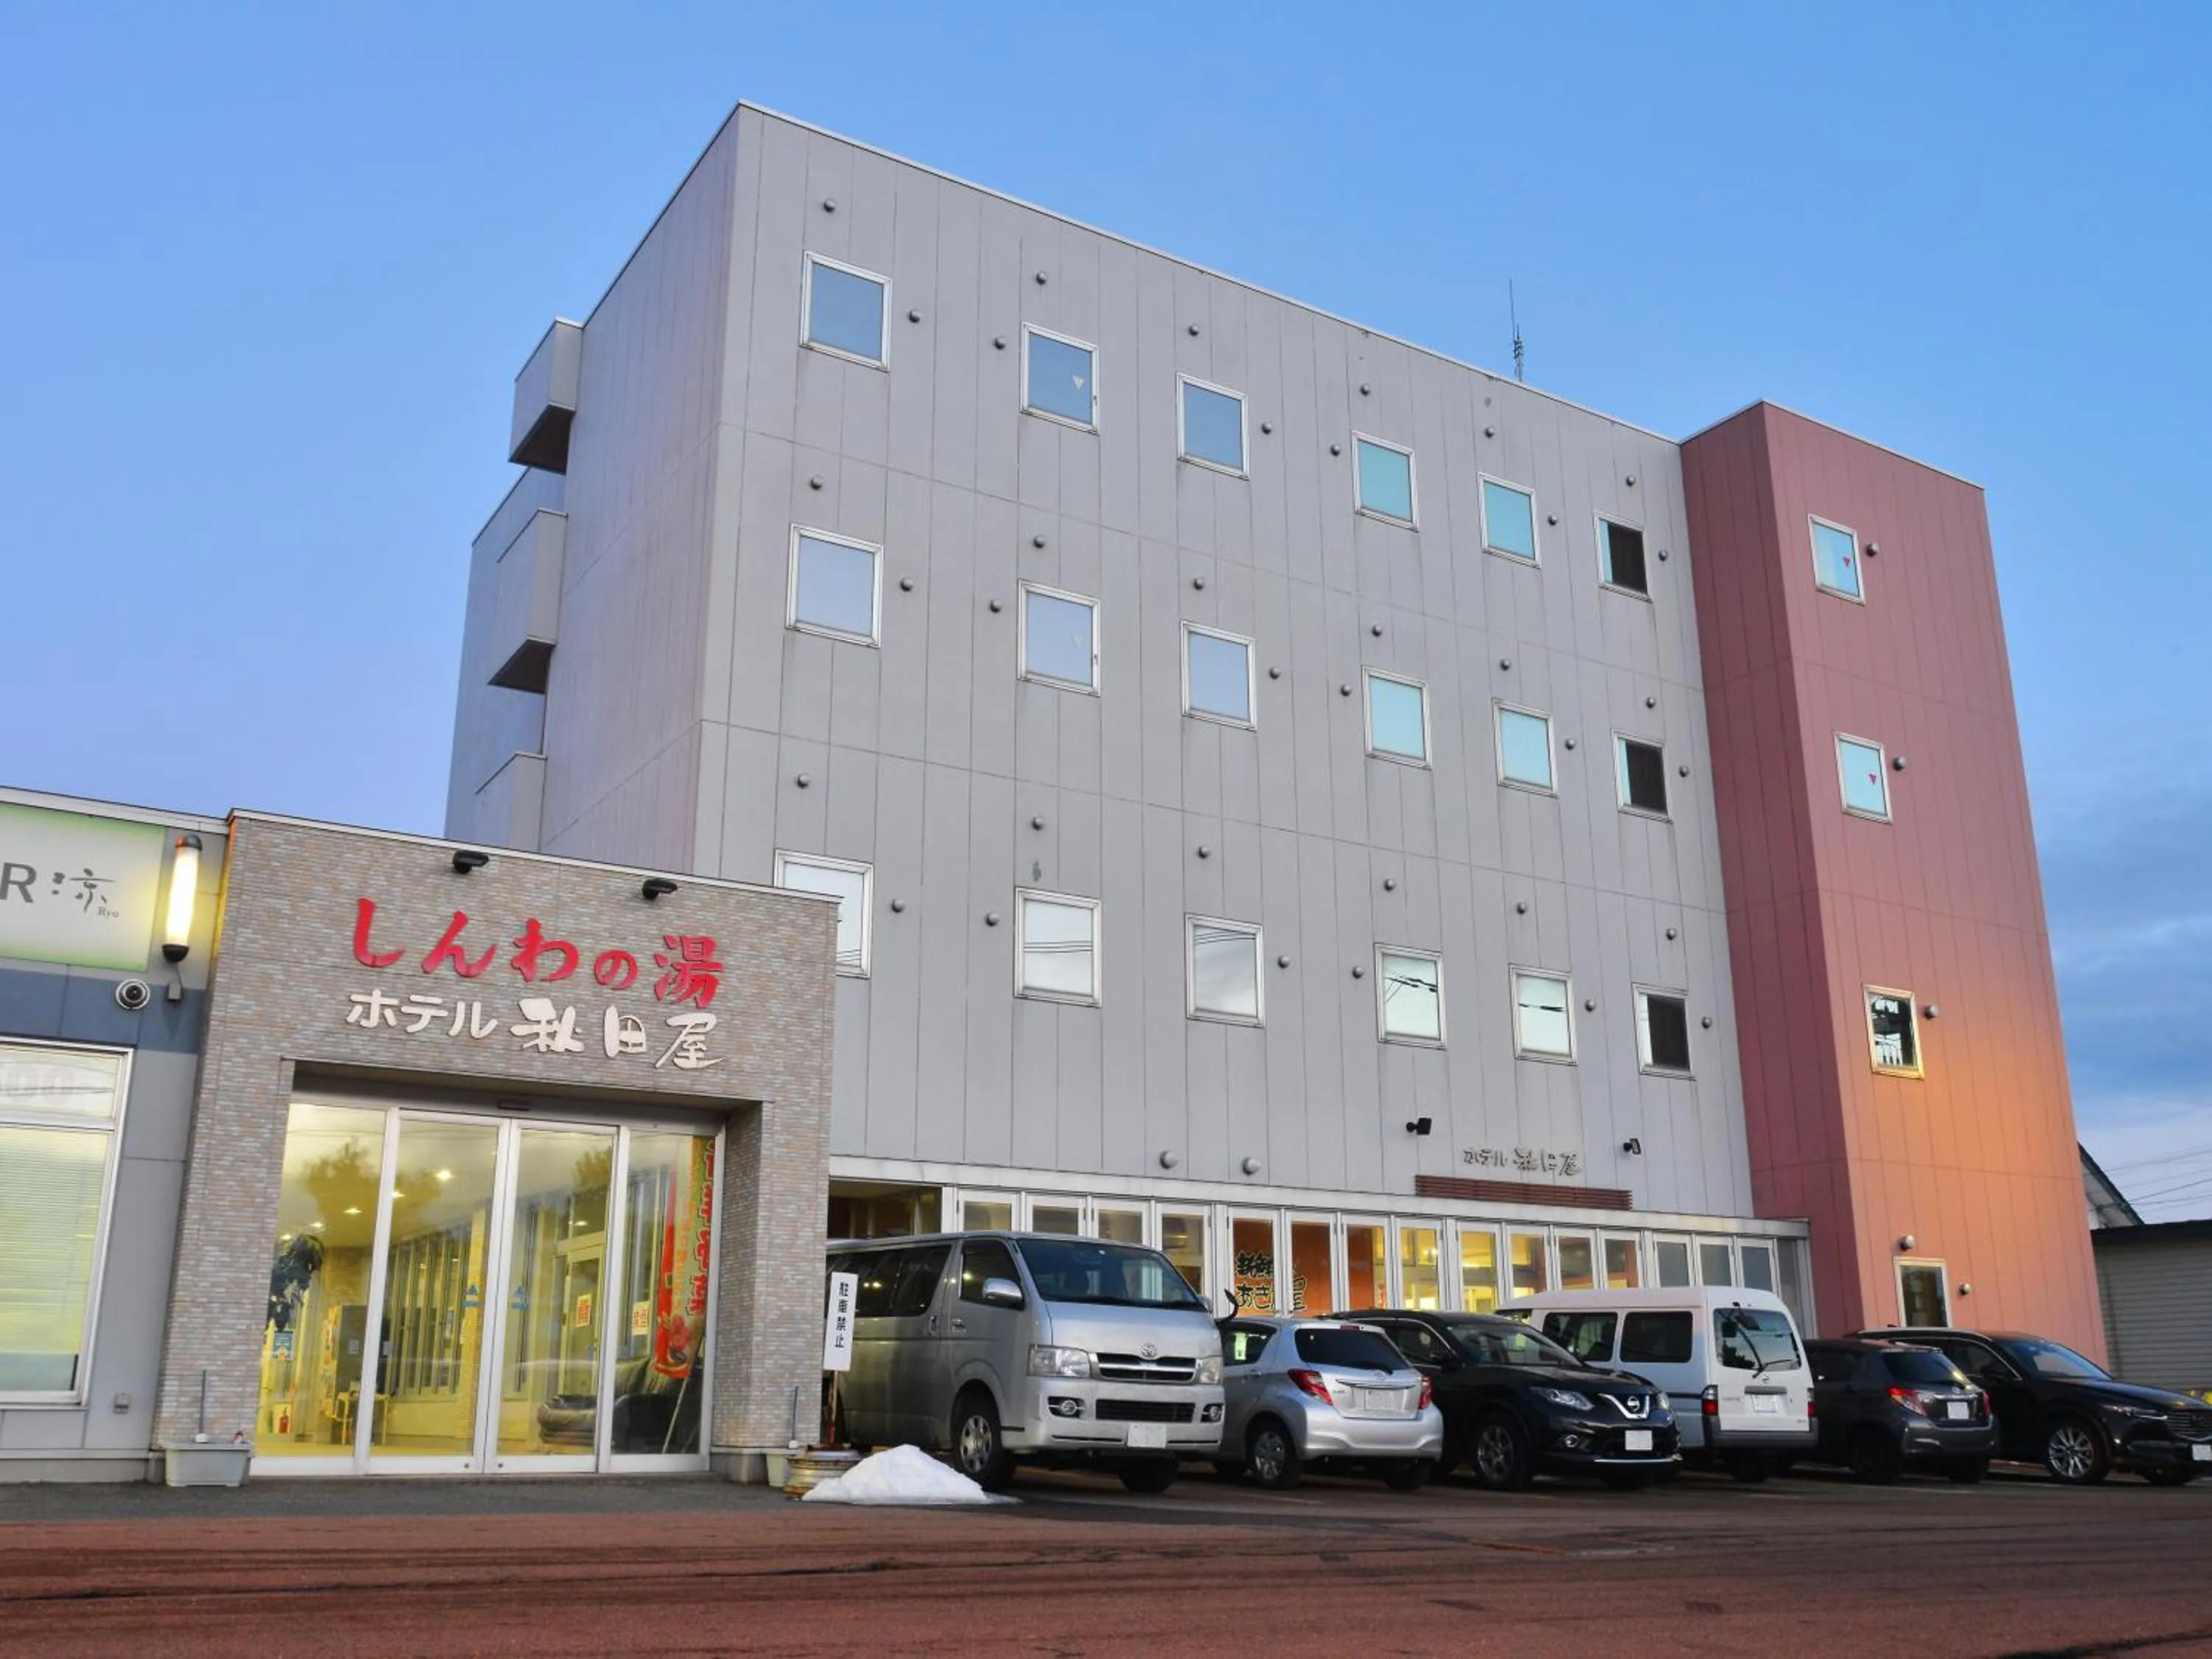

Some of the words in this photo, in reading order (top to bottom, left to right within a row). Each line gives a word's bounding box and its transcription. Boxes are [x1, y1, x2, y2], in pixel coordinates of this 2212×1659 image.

[352, 897, 723, 1009] しんわの湯
[834, 1281, 849, 1349] 駐車禁止
